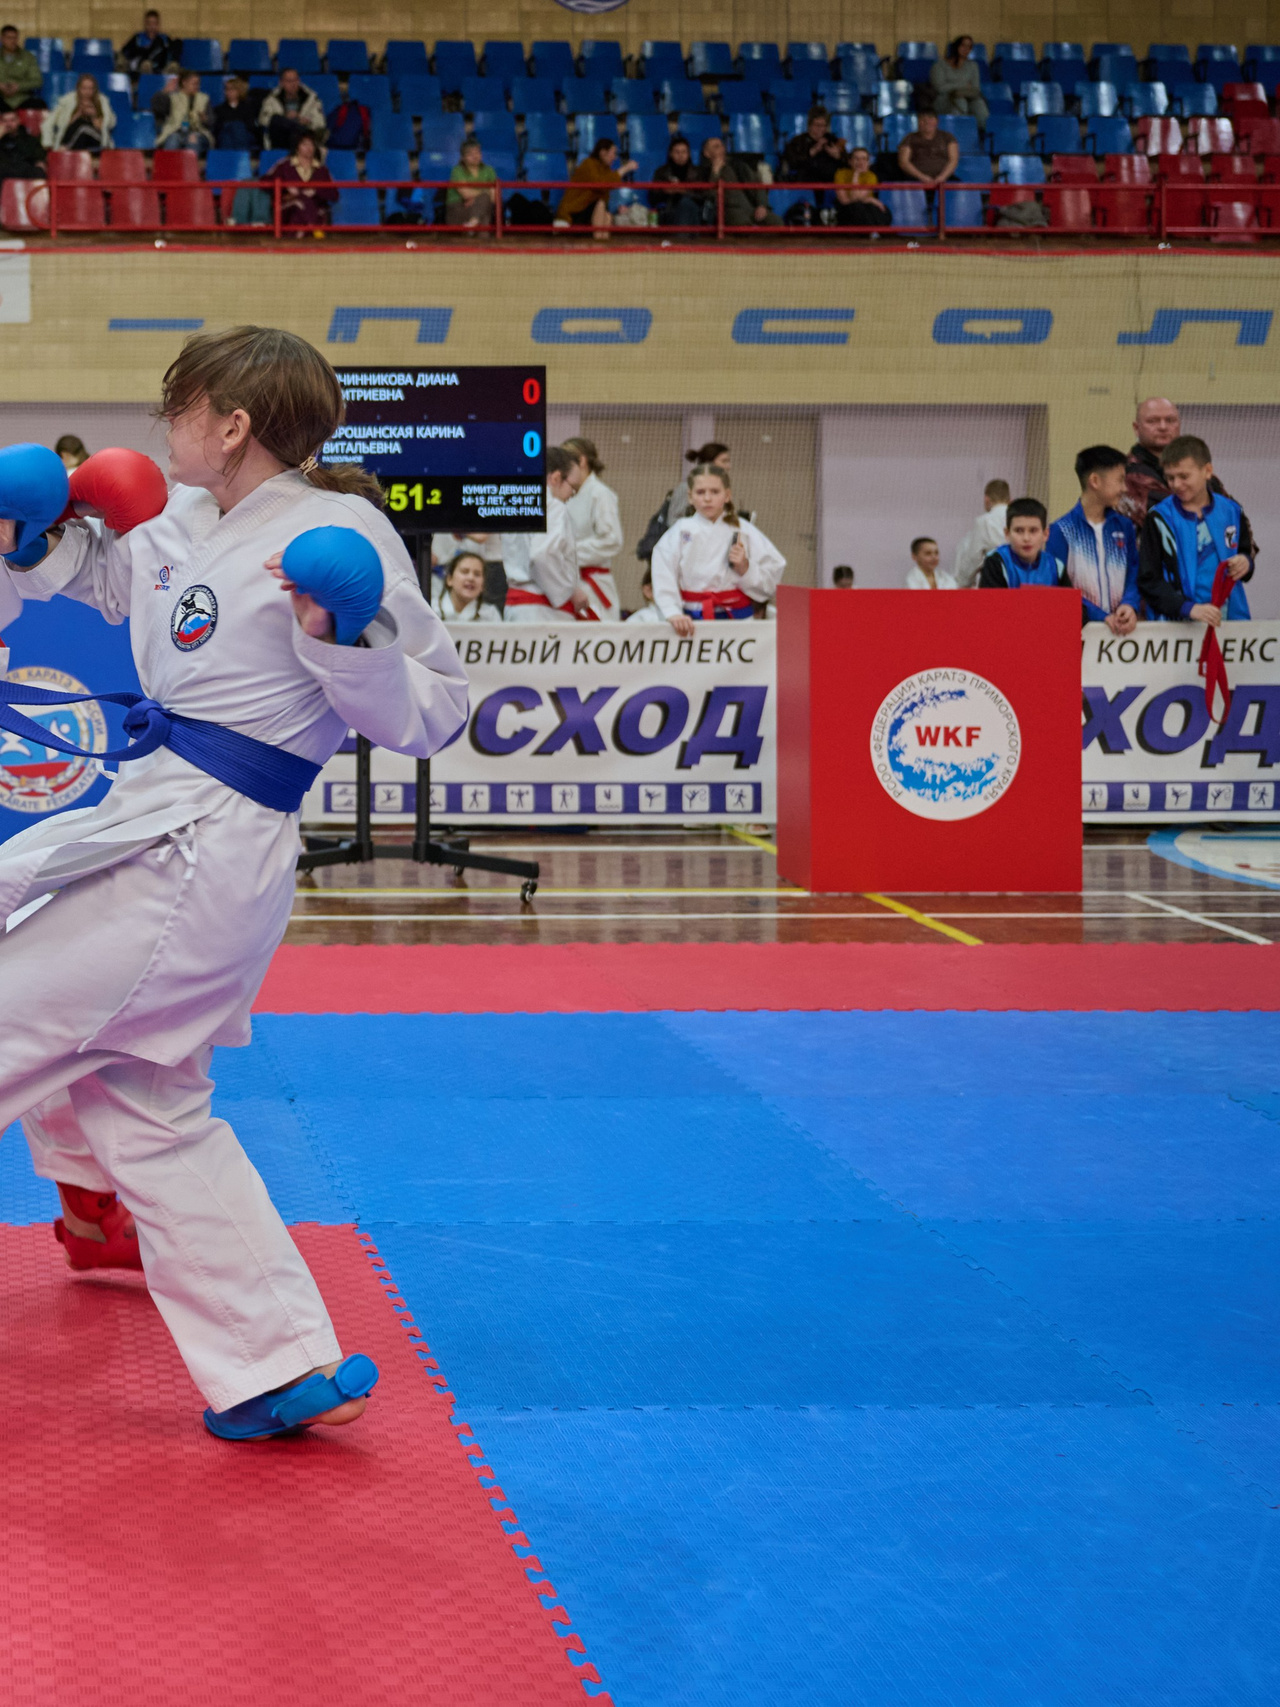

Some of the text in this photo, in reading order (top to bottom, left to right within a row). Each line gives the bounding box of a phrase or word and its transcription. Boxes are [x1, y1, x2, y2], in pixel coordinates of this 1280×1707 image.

[326, 306, 1274, 346] ПОСОЛ
[336, 373, 459, 388] ЧИННИКОВА ДИАНА
[522, 378, 541, 405] 0
[341, 388, 405, 401] ИТРИЕВНА
[416, 425, 465, 439] КАРИНА
[522, 430, 541, 458] 0
[322, 441, 402, 454] ВИТАЛЬЕВНА
[462, 484, 542, 496] КУМИТЭ ДЕВУШКИ
[462, 496, 485, 506] 14-15
[477, 506, 544, 518] QUARTER-FINAL
[572, 638, 757, 664] КОМПЛЕКС
[1096, 637, 1278, 664] КОМПЕКС
[332, 685, 769, 770] СХОД
[876, 762, 904, 800] РСОО
[917, 670, 967, 686] КАРАТЭ
[969, 676, 1019, 766] ПРИМОРСКОГО
[915, 725, 982, 748] WKF
[1081, 684, 1280, 769] ХОД
